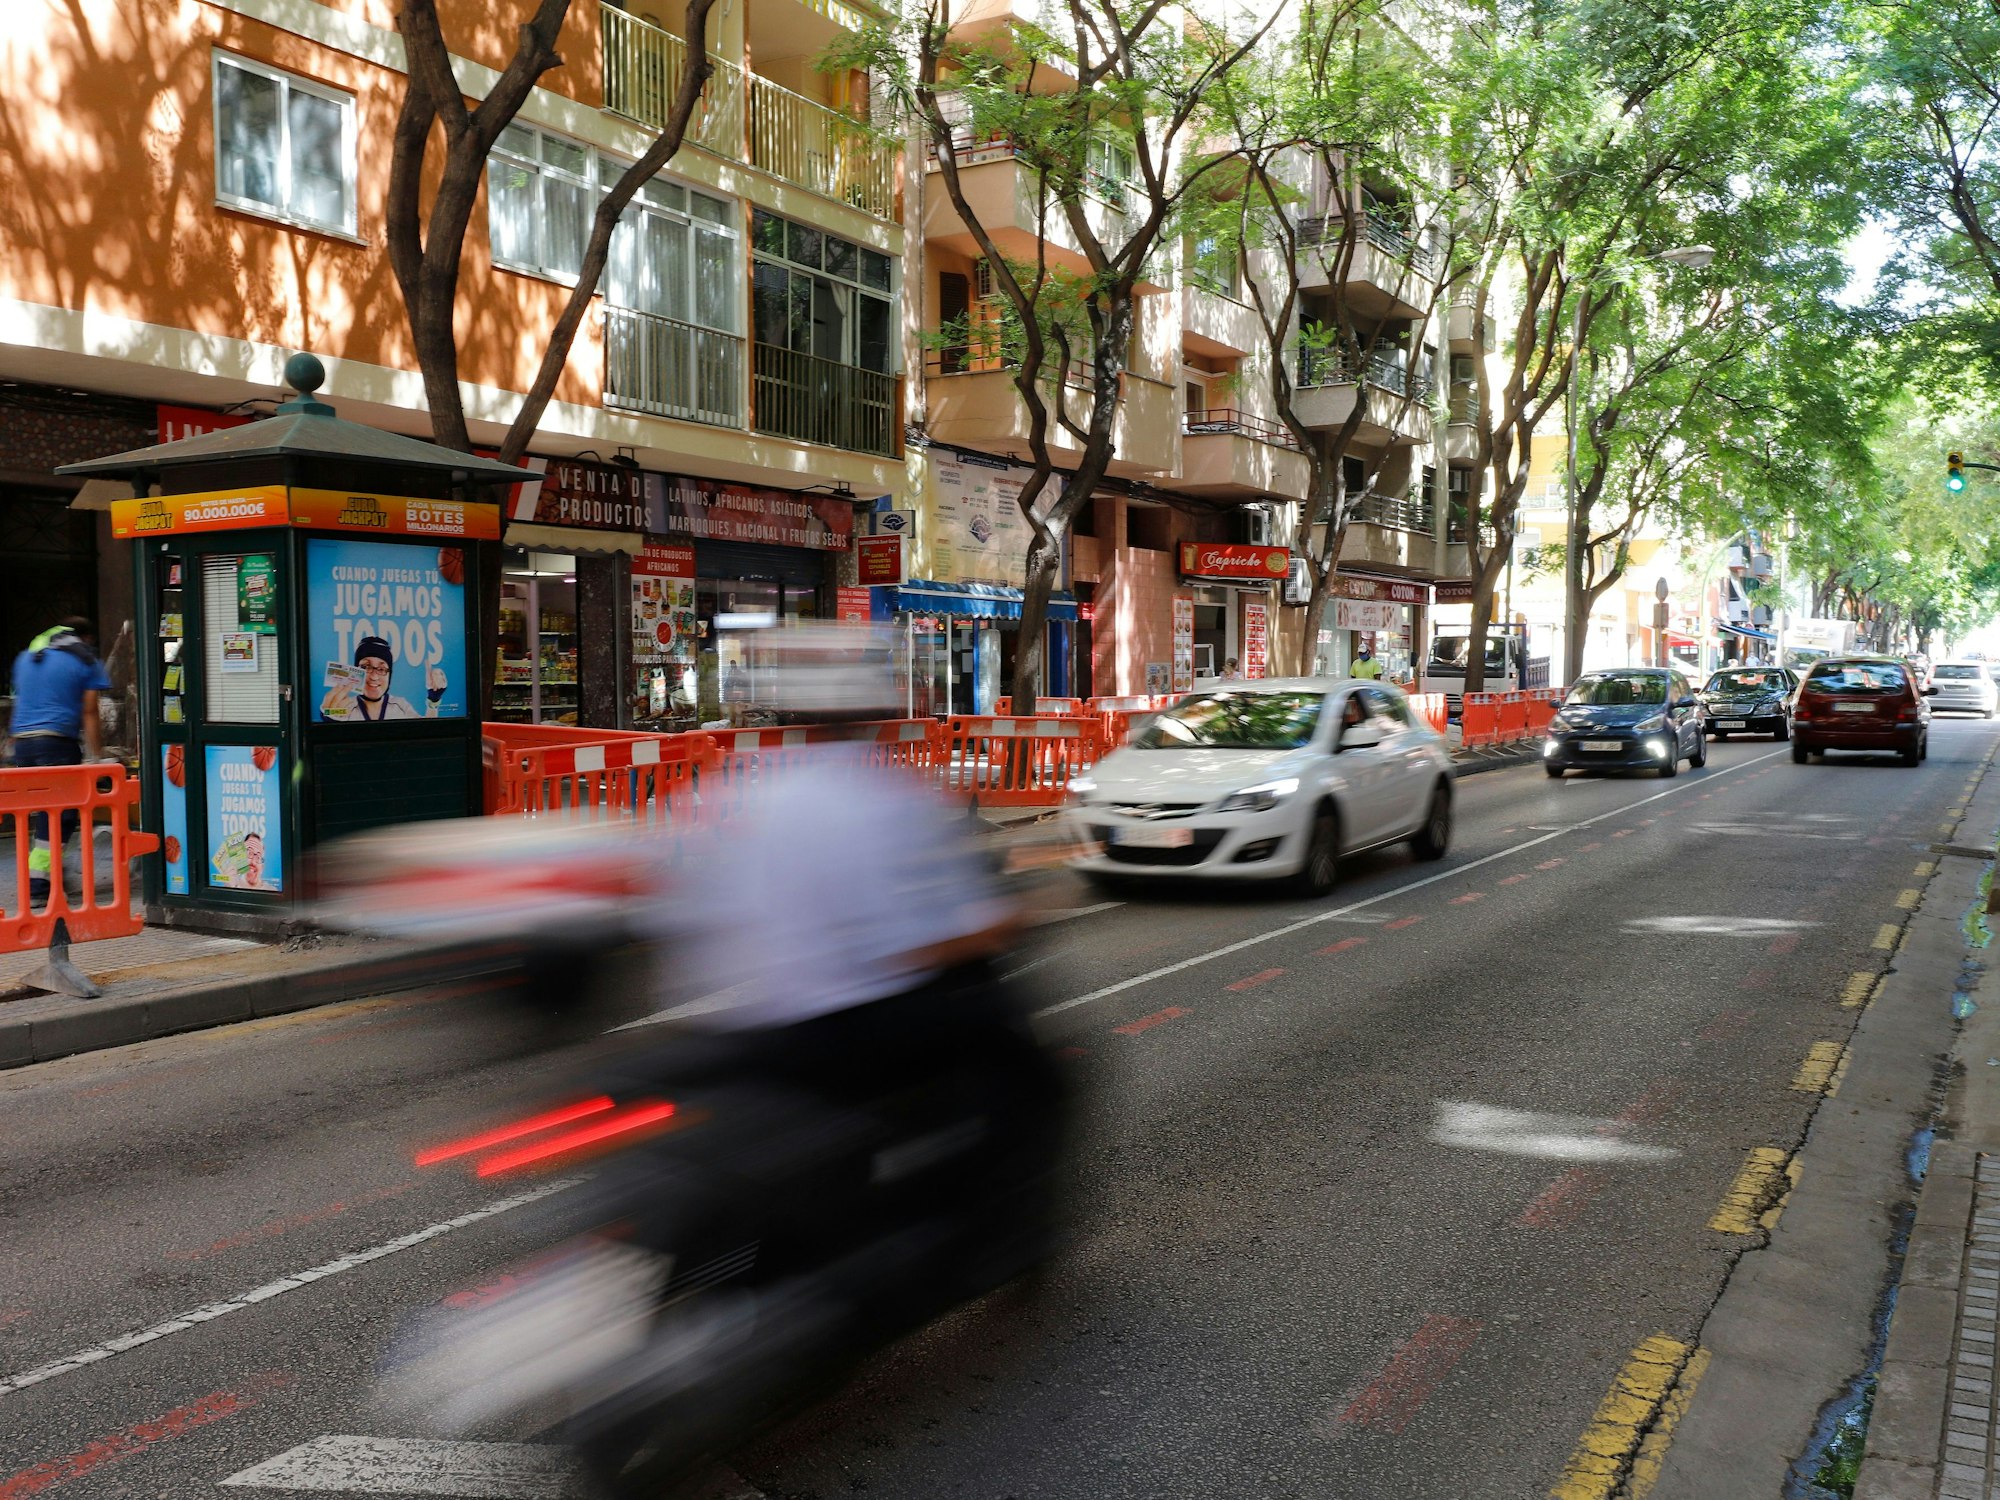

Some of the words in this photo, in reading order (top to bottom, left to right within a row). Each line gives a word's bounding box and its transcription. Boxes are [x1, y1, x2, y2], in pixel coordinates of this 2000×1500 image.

[559, 466, 620, 495] VENTA
[631, 476, 652, 499] DE
[183, 502, 265, 521] 90.000.000€
[348, 497, 377, 512] EURO
[406, 501, 429, 510] CADA
[431, 502, 464, 512] VIERNES
[559, 497, 652, 528] PRODUCTOS
[668, 487, 712, 508] LATINOS,
[715, 493, 768, 514] AFRICANOS,
[770, 499, 816, 520] ASIÁTICOS,
[134, 513, 174, 531] JACKPOT
[338, 510, 388, 528] JACKPOT
[406, 509, 464, 524] BOTES
[406, 522, 464, 533] MILLONARIOS
[668, 514, 733, 537] MARROQUIES,
[736, 522, 779, 541] NACIONAL
[781, 527, 787, 541] Y
[789, 528, 820, 545] FRUTOS
[822, 532, 847, 548] SECOS
[652, 549, 660, 558] DE
[661, 550, 692, 560] PRODUCTOS
[1201, 551, 1261, 571] Capricho
[332, 566, 377, 582] CUANDO
[382, 568, 421, 584] JUEGAS
[647, 561, 680, 573] AFRICANOS
[333, 583, 442, 618] JUGAMOS
[1391, 585, 1416, 600] COTON
[1437, 587, 1472, 596] COTON
[220, 763, 265, 782] CUANDO
[222, 782, 250, 794] JUEGAS
[221, 797, 266, 814] JUGAMOS
[221, 813, 266, 839] TODOS
